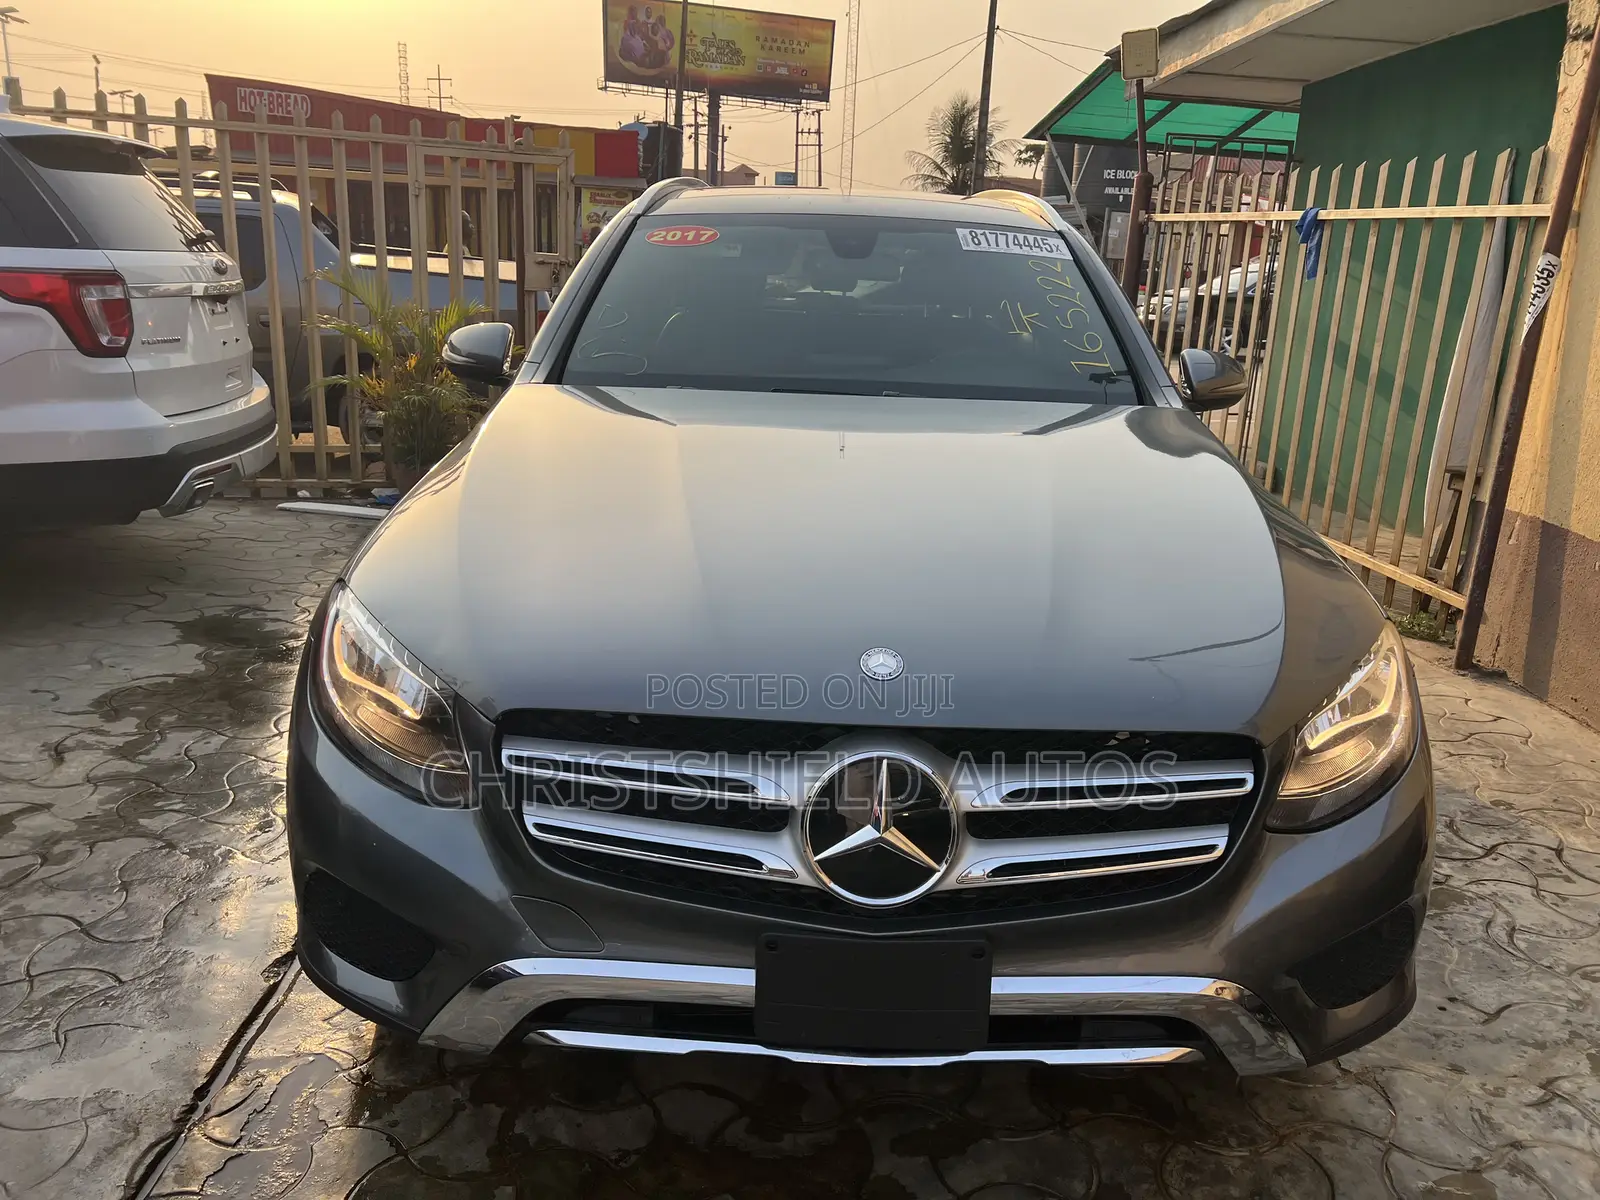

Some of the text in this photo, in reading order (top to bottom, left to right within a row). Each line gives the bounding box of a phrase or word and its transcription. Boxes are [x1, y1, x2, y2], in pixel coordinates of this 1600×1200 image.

[755, 35, 811, 48] RAMADAN
[760, 43, 806, 55] KAREEM
[266, 91, 311, 119] BREAD
[1103, 169, 1116, 179] ICE
[650, 230, 715, 242] 2017
